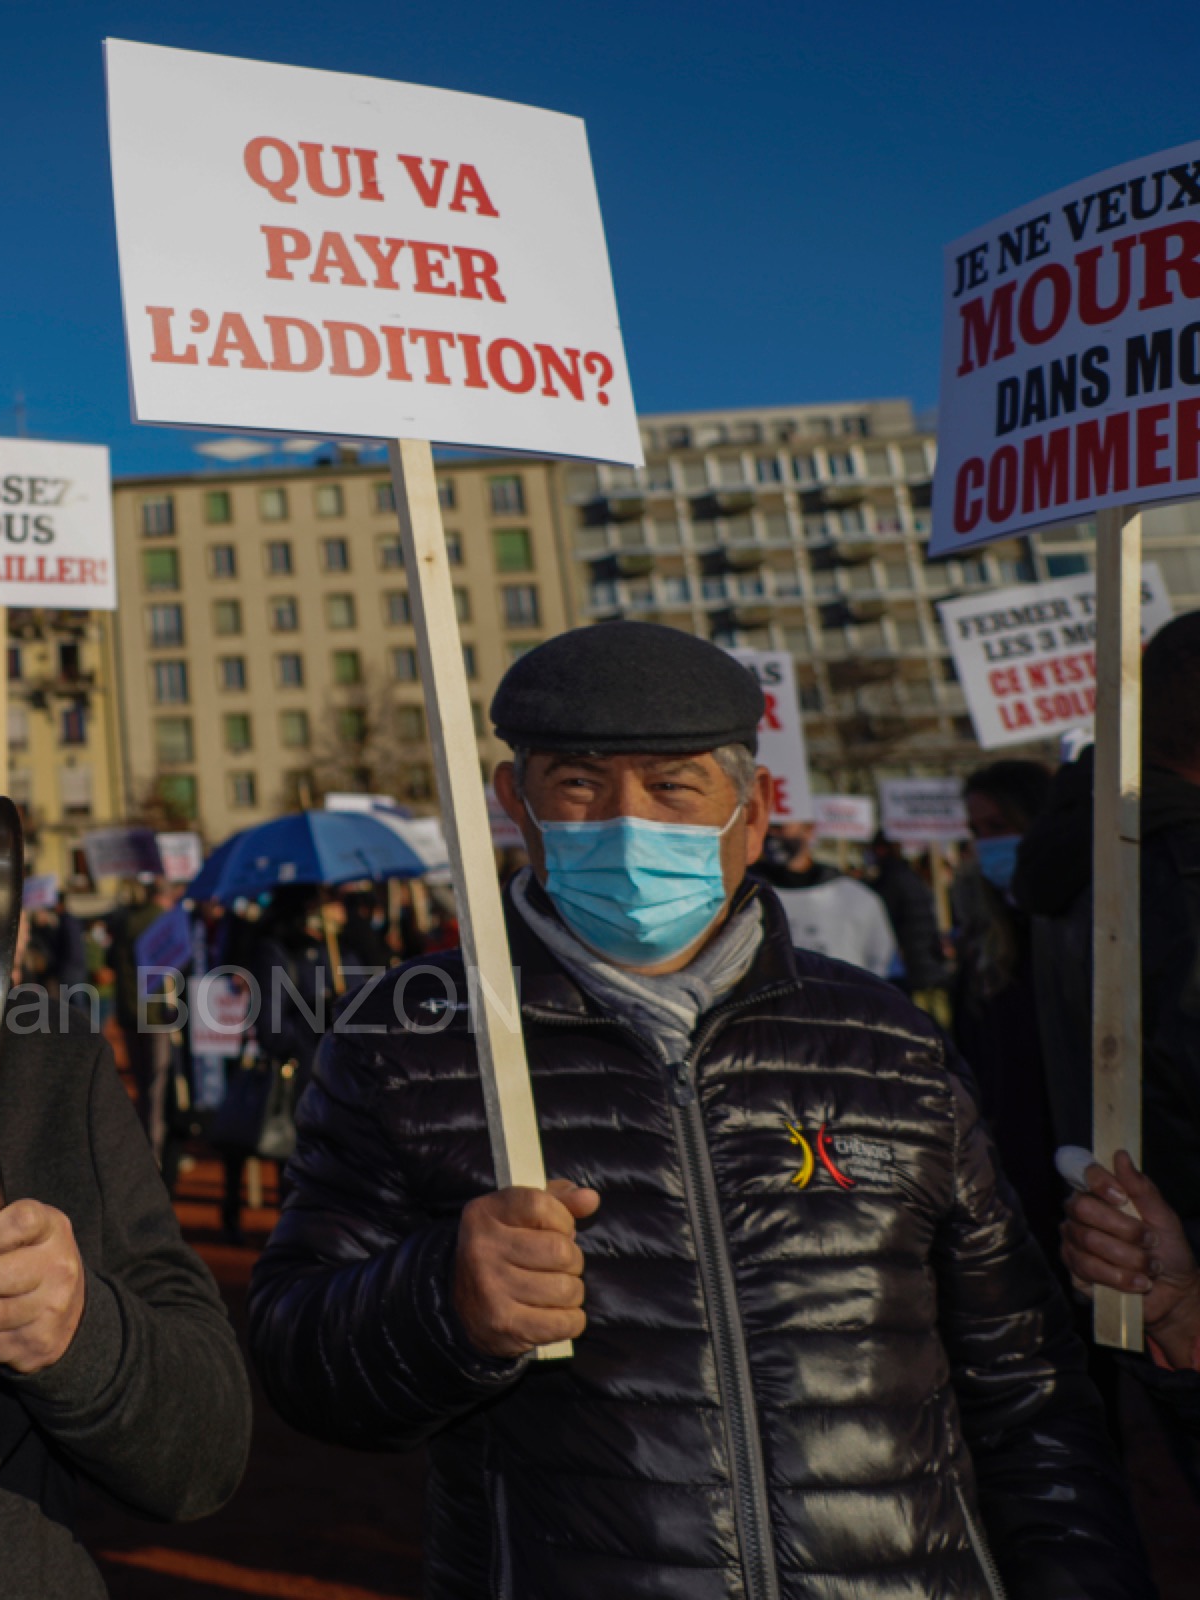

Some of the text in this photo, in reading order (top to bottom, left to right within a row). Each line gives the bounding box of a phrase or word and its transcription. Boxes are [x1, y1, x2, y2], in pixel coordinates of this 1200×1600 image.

[243, 136, 500, 218] QUI VA
[260, 224, 507, 303] PAYER
[953, 160, 1200, 297] JE NE VEUX
[956, 220, 1200, 378] MOUR
[145, 305, 614, 406] L'ADDITION?
[995, 345, 1110, 437] DANS
[957, 598, 1071, 639] FERMER
[982, 631, 1033, 662] LES
[1037, 627, 1057, 650] 3
[988, 666, 1023, 697] CE
[998, 701, 1034, 731] LA
